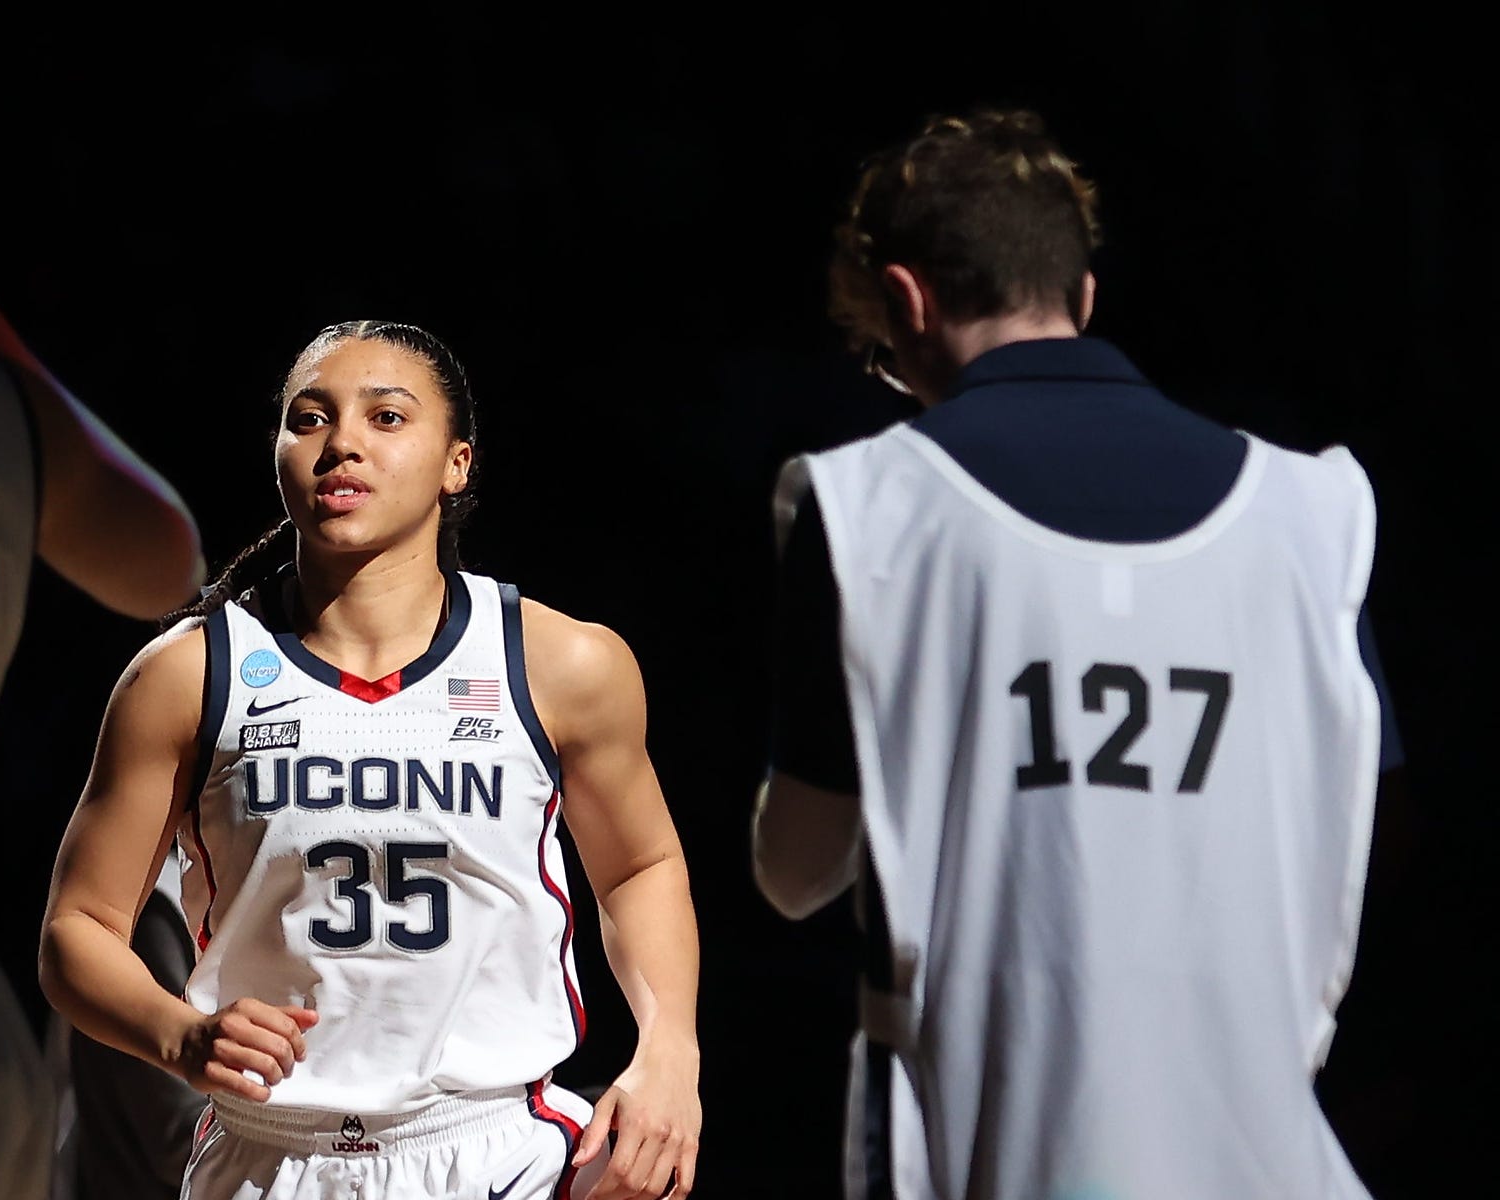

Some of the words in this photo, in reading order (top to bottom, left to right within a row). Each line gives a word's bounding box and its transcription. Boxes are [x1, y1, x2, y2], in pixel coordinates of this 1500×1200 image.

[457, 716, 494, 728] BIG
[1009, 661, 1232, 793] 127
[452, 728, 504, 739] EAST
[244, 734, 299, 749] CHANGE
[245, 757, 502, 820] UCONN
[305, 840, 452, 951] 35
[331, 1142, 379, 1152] UCONN
